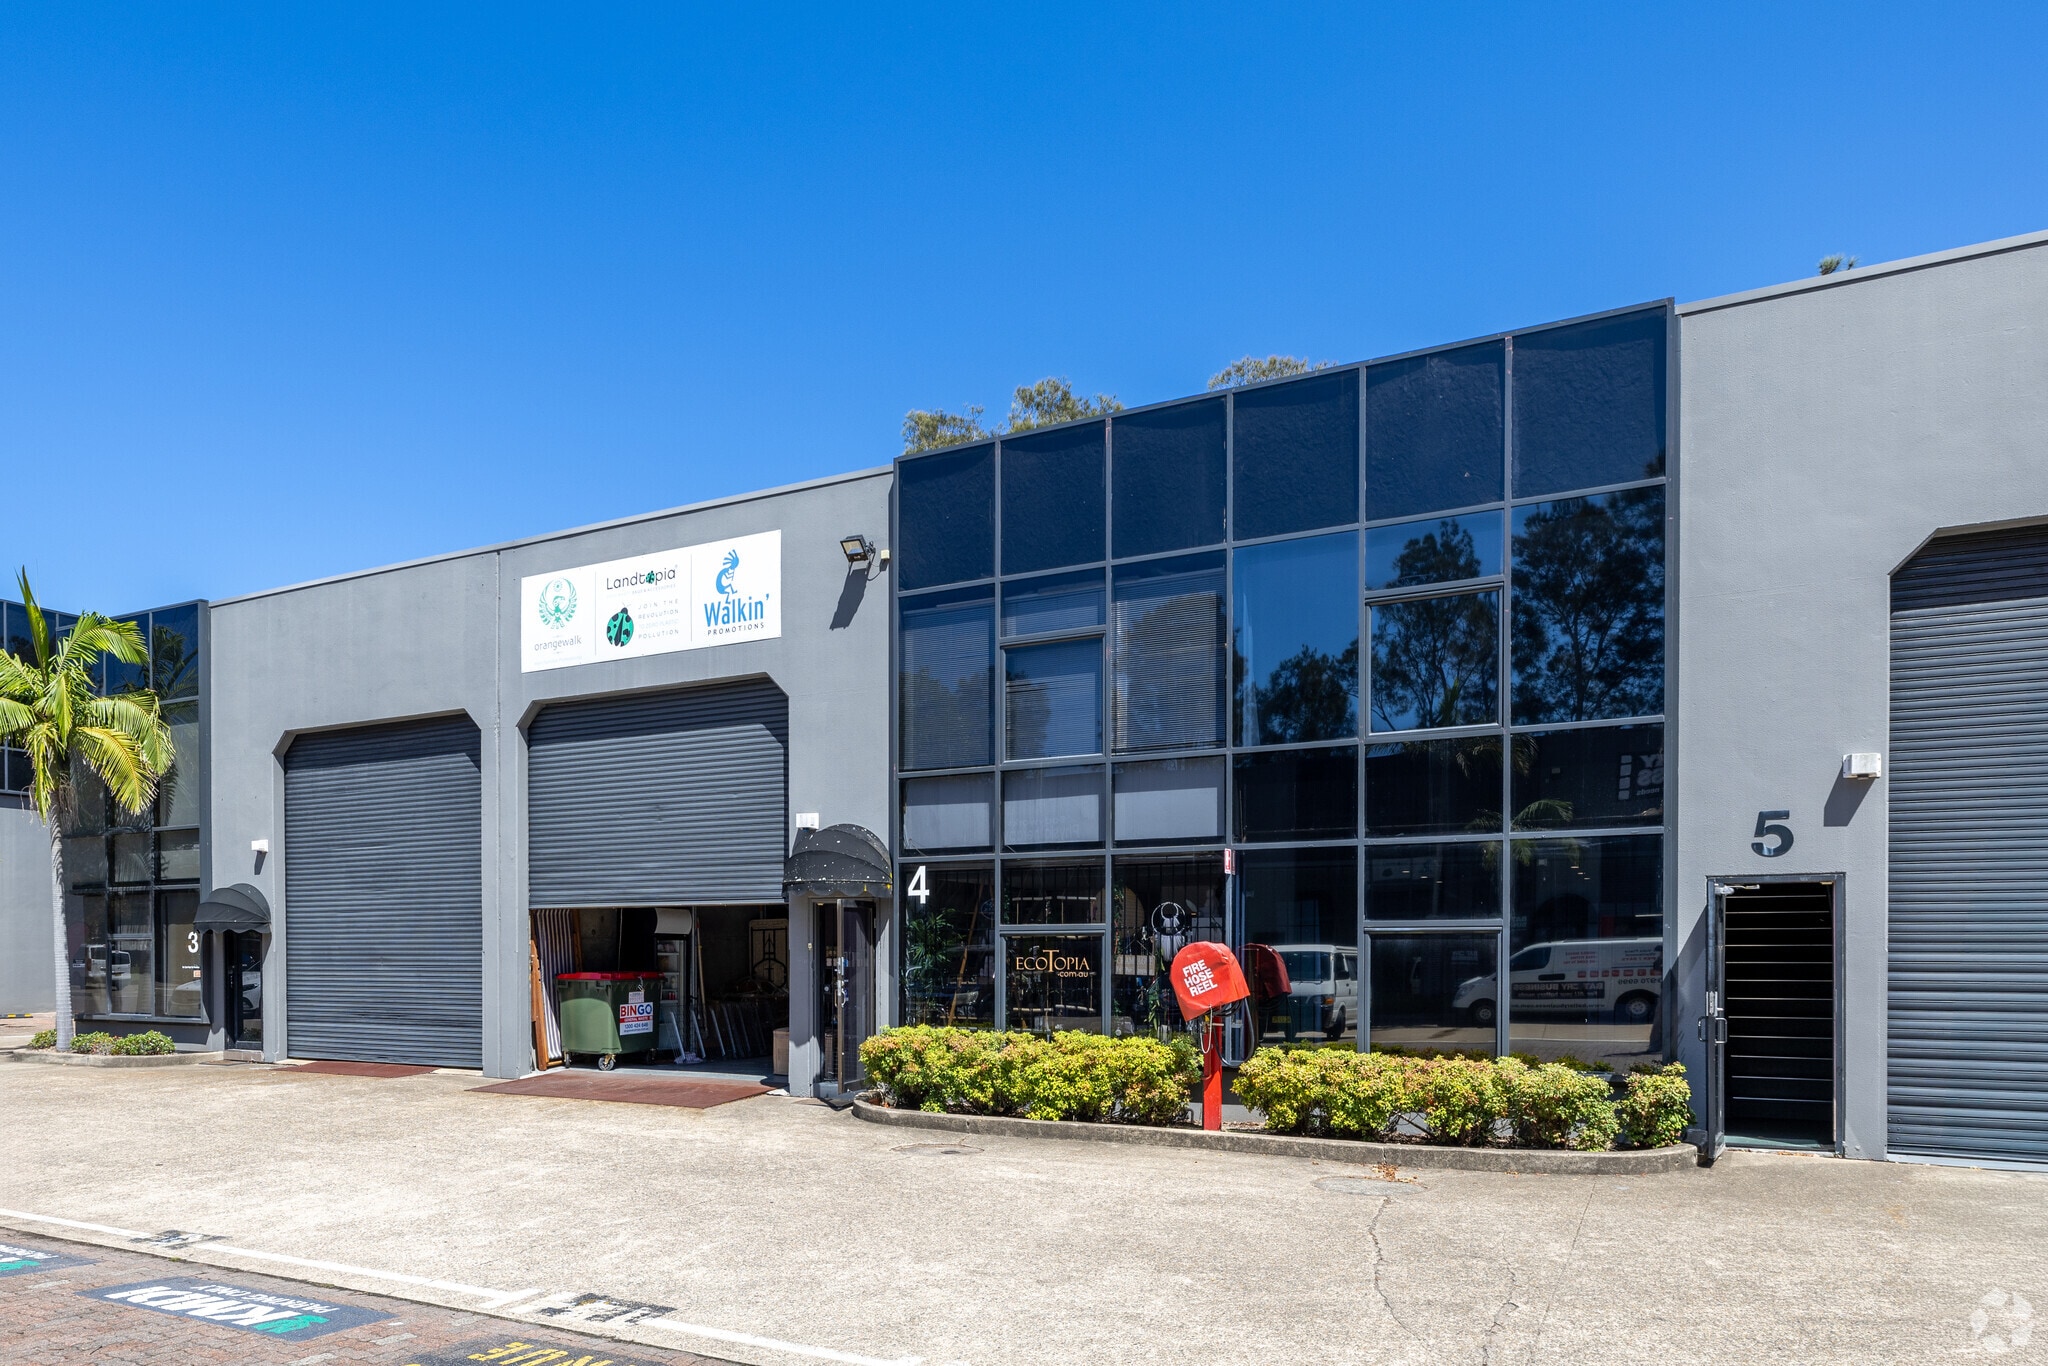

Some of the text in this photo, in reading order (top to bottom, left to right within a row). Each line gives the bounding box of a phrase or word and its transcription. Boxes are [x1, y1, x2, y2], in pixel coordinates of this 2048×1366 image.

[638, 602, 658, 610] JOIN
[638, 609, 679, 619] REVOLUTION
[638, 629, 679, 639] POLLUTION
[707, 622, 765, 636] PROMOTIONS
[534, 635, 582, 651] orangewalk
[1751, 810, 1794, 857] 5
[908, 866, 930, 904] 4
[187, 931, 199, 954] 3
[1182, 959, 1206, 978] FIRE
[1184, 969, 1214, 988] HOSE
[1189, 979, 1218, 997] REEL
[620, 1004, 652, 1016] BINGO
